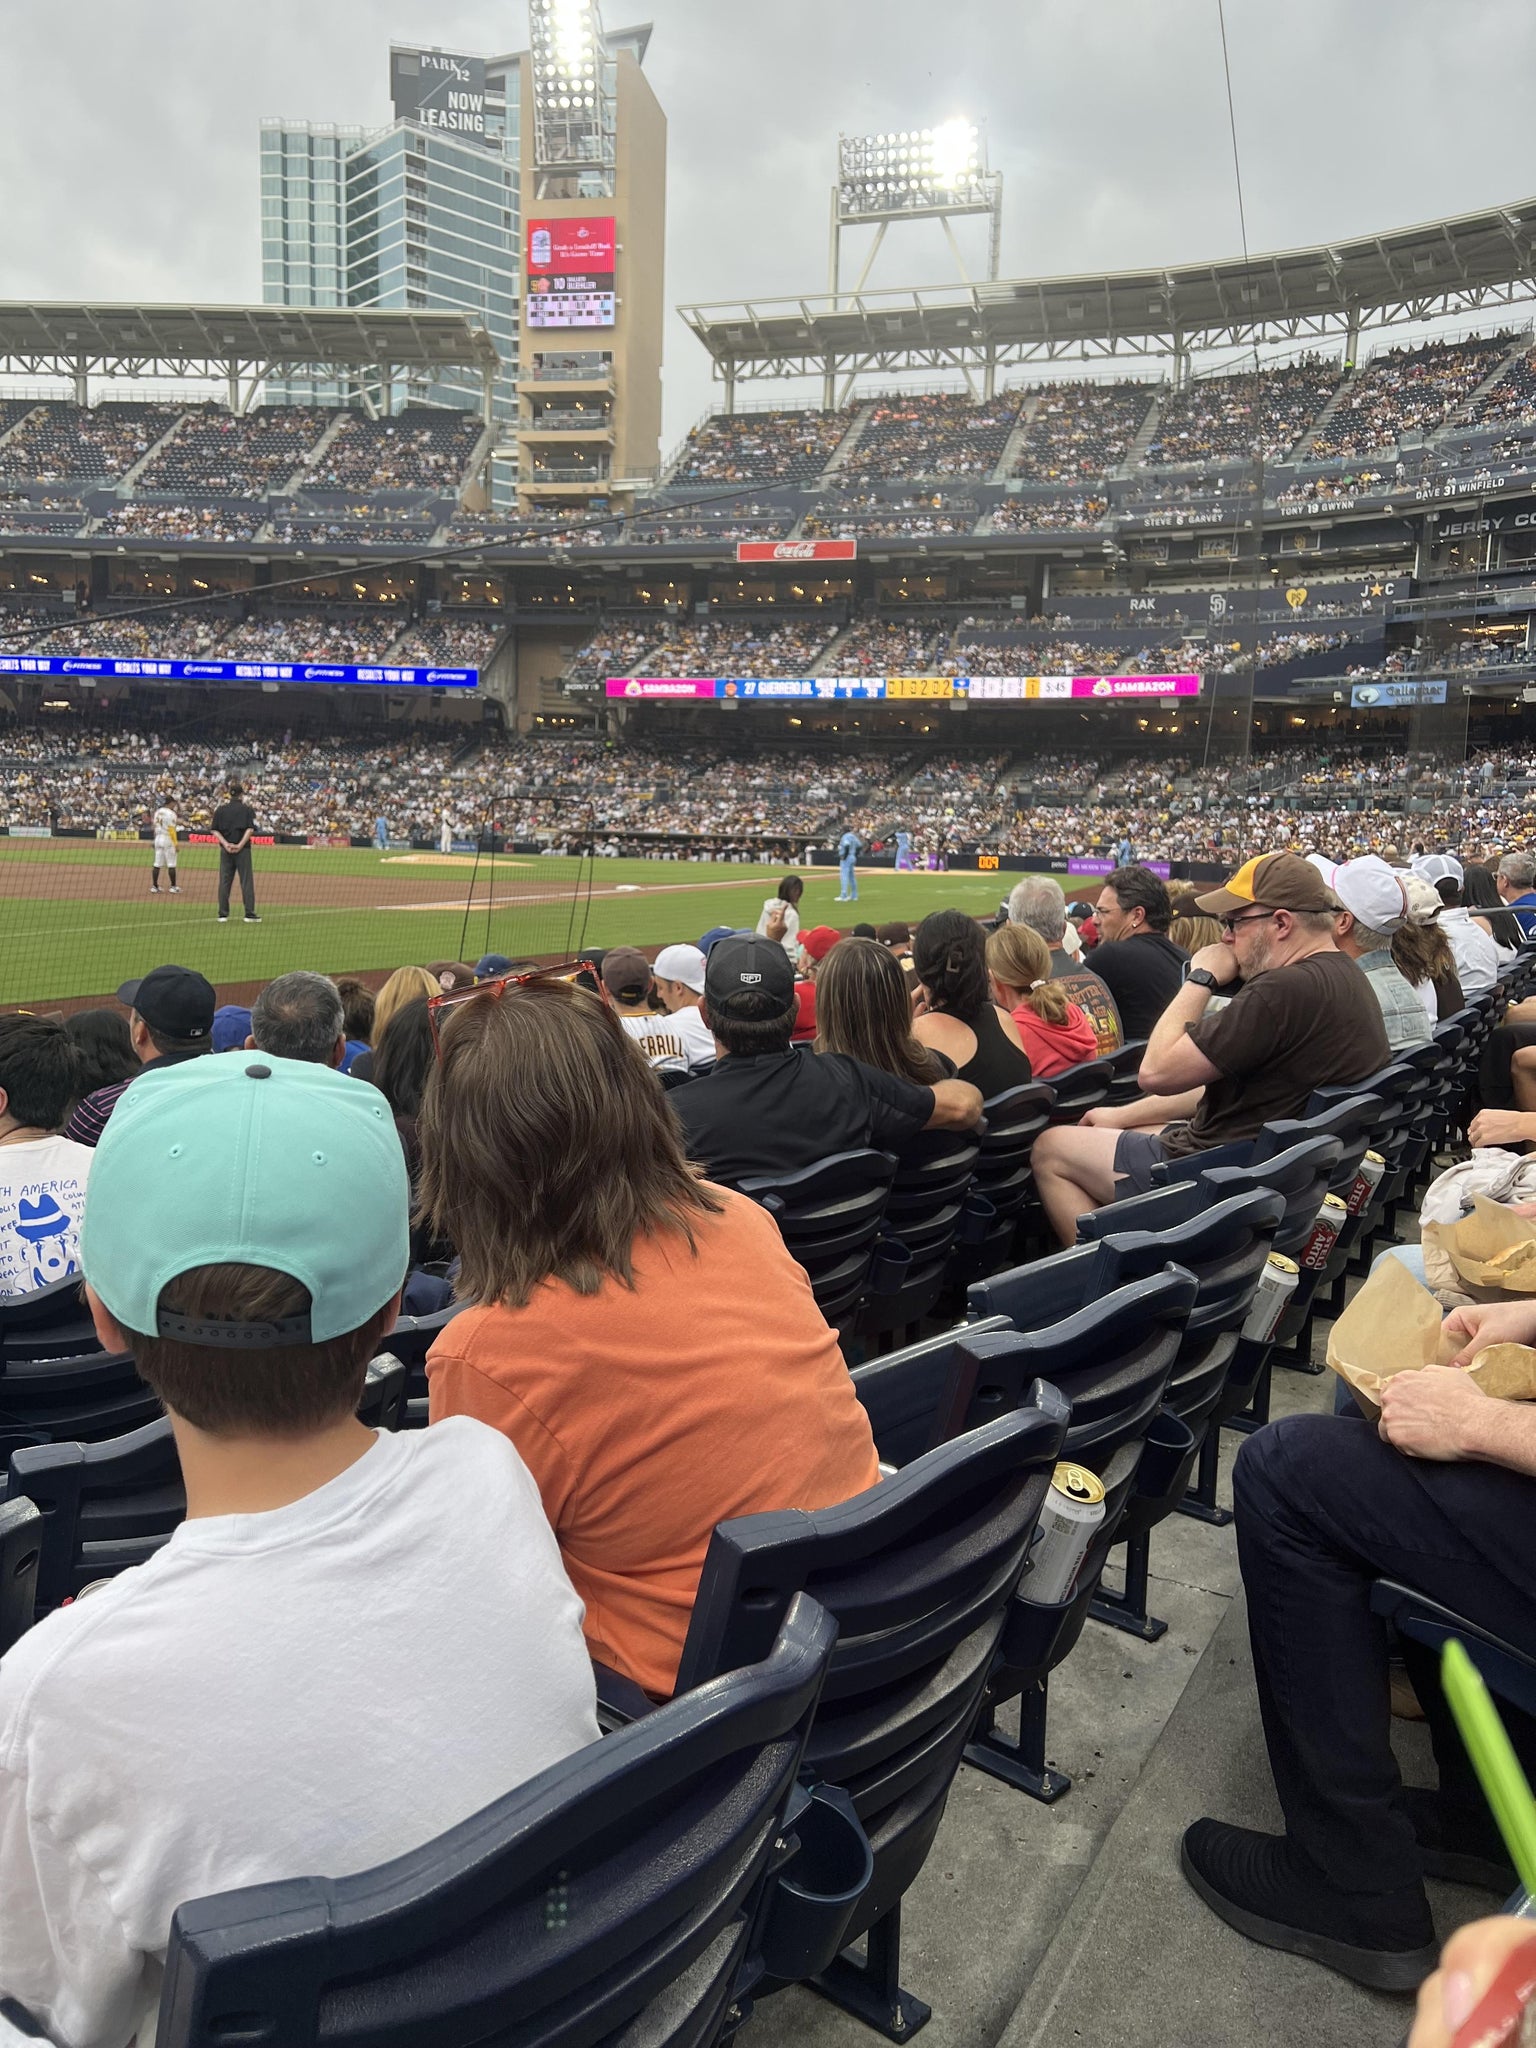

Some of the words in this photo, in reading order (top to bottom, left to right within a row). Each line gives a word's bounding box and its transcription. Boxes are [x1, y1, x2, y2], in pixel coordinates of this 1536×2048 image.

[421, 55, 460, 73] PARK
[448, 91, 484, 113] NOW
[420, 108, 484, 132] LEASING
[1416, 488, 1440, 500] DAVE
[1444, 484, 1456, 497] 31
[1459, 477, 1505, 493] WINFIELD
[1281, 507, 1303, 516] TONY
[1308, 503, 1319, 514] 19
[1321, 500, 1355, 512] GWYNN
[1144, 517, 1172, 527] STEVE
[1189, 514, 1224, 524] GARVEY
[1439, 516, 1505, 537] JERRY
[1130, 598, 1156, 611] RAK
[643, 684, 696, 694] SAMBAZON
[744, 682, 756, 694] 27
[758, 682, 801, 695] GUERRERO
[1113, 681, 1176, 693] SAMBAZON
[639, 1034, 684, 1058] ERRILL
[20, 1179, 78, 1197] AMERICA
[1306, 1233, 1326, 1265] ARTO
[1314, 1236, 1333, 1269] STELL
